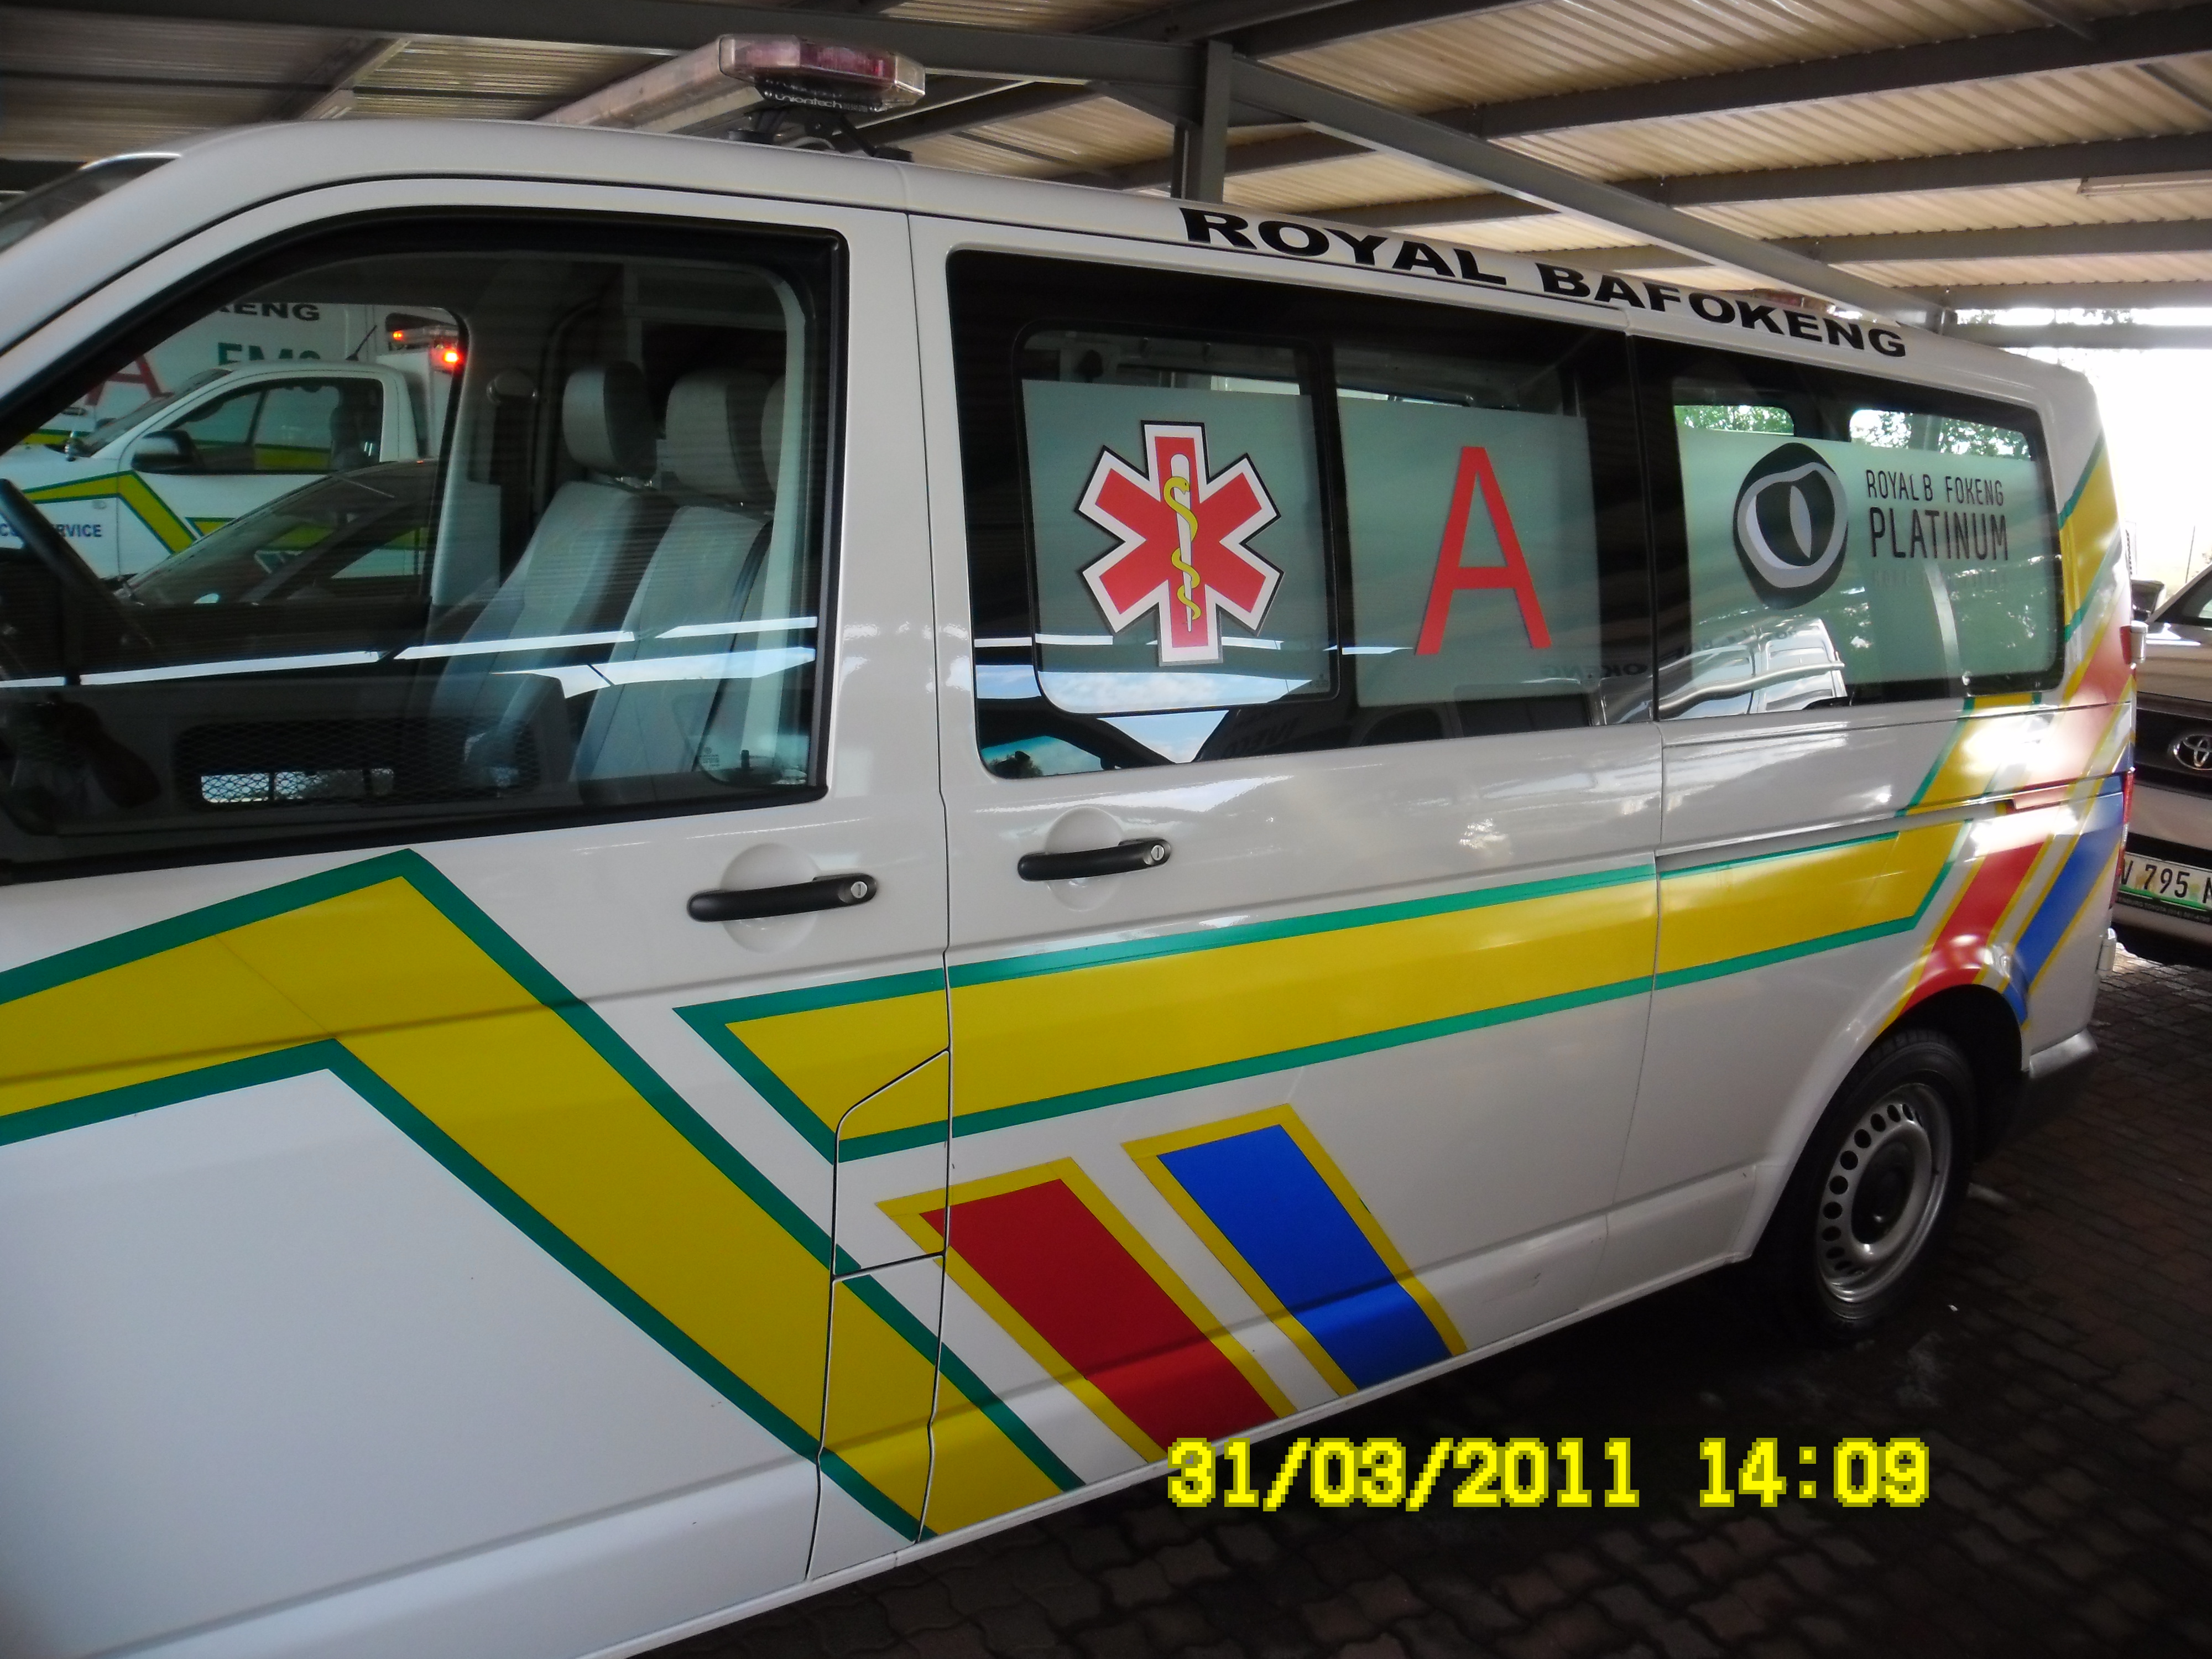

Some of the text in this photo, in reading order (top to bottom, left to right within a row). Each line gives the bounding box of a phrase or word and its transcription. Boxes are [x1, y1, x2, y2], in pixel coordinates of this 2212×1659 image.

[1180, 207, 1906, 357] ROYAL BAFOKENG
[220, 303, 320, 321] ENG
[1414, 446, 1552, 655] A
[1869, 507, 2008, 561] PLATINUM
[2143, 864, 2190, 898] 795
